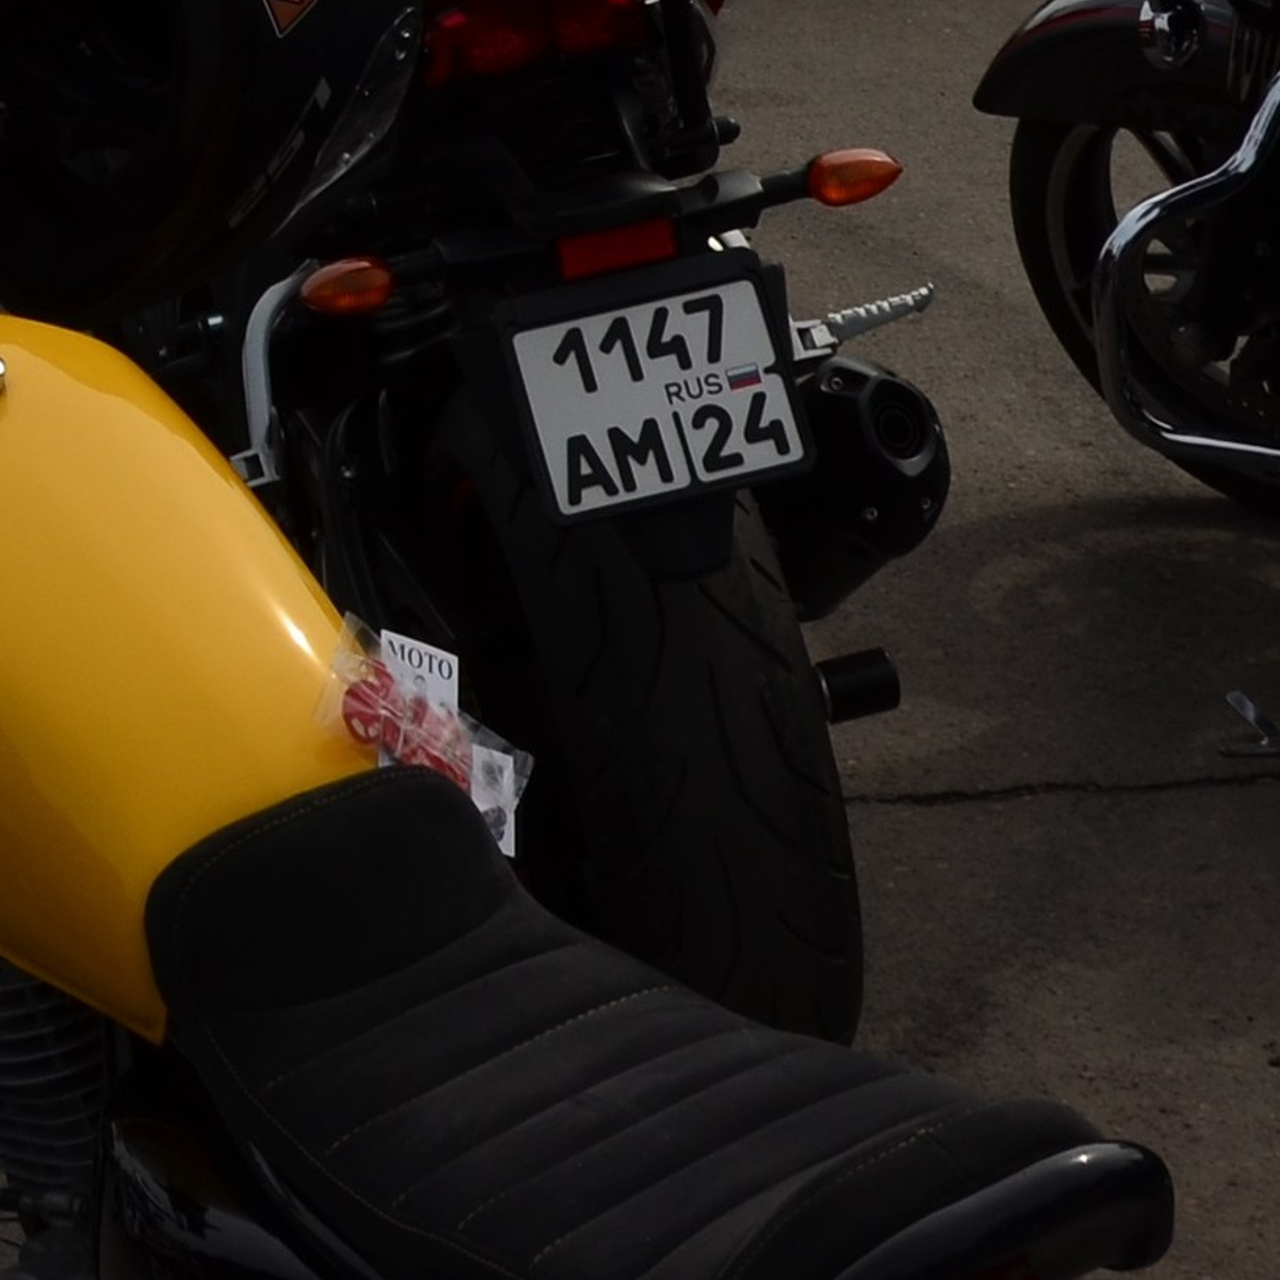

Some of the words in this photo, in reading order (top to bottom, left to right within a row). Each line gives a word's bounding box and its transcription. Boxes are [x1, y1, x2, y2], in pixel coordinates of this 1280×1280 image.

[552, 294, 723, 393] 1147
[664, 374, 723, 404] RUS
[567, 418, 674, 506] AM
[692, 391, 790, 473] 24
[388, 639, 454, 681] MOTO
